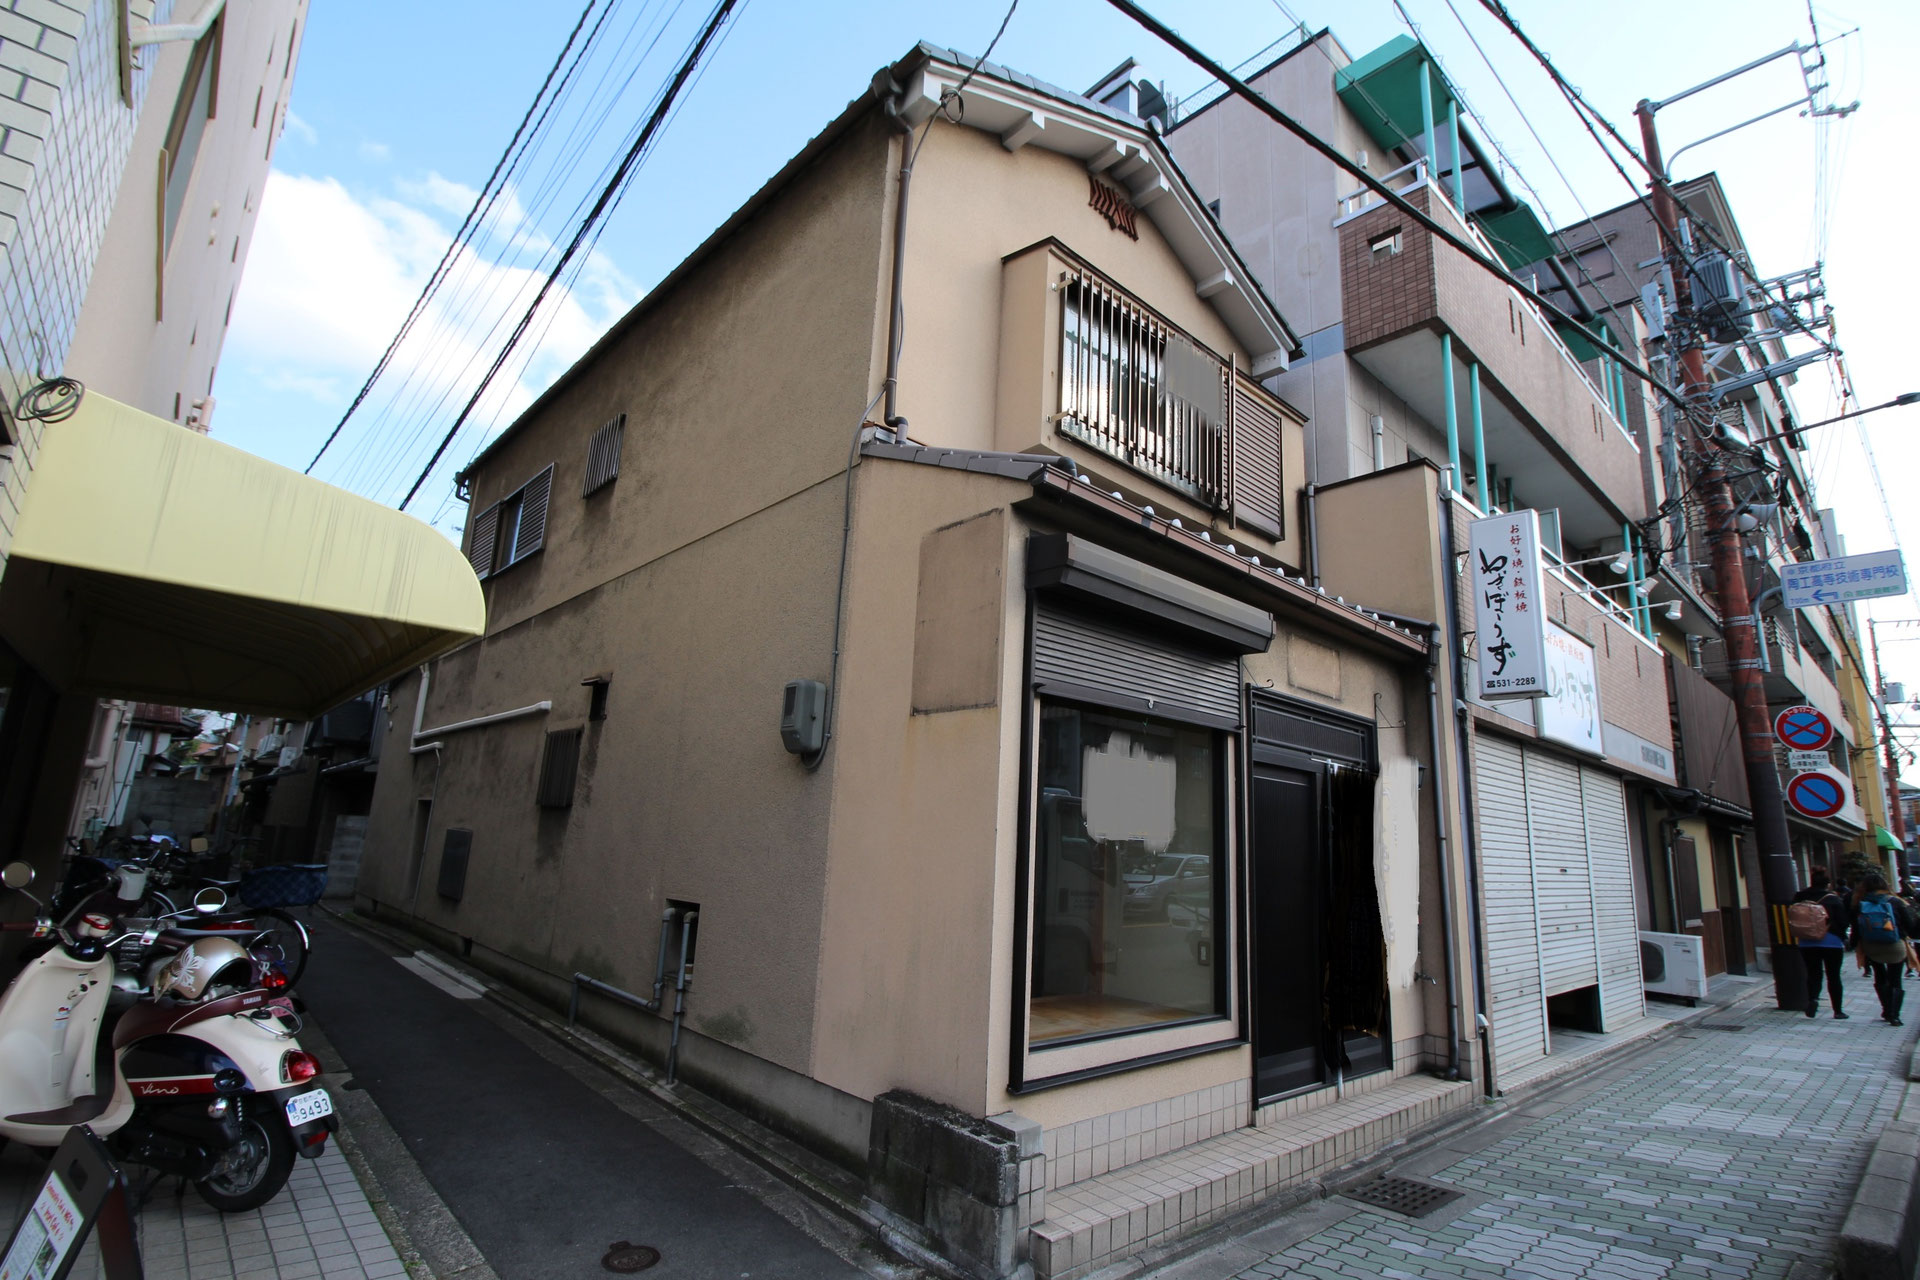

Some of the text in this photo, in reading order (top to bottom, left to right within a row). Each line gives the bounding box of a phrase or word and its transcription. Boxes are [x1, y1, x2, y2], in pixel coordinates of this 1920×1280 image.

[1797, 561, 1846, 575] 京都府立
[1496, 678, 1536, 688] 531-2289
[243, 995, 262, 1005] YAMAHA
[140, 1082, 180, 1095] Vino
[300, 1098, 330, 1120] 9493
